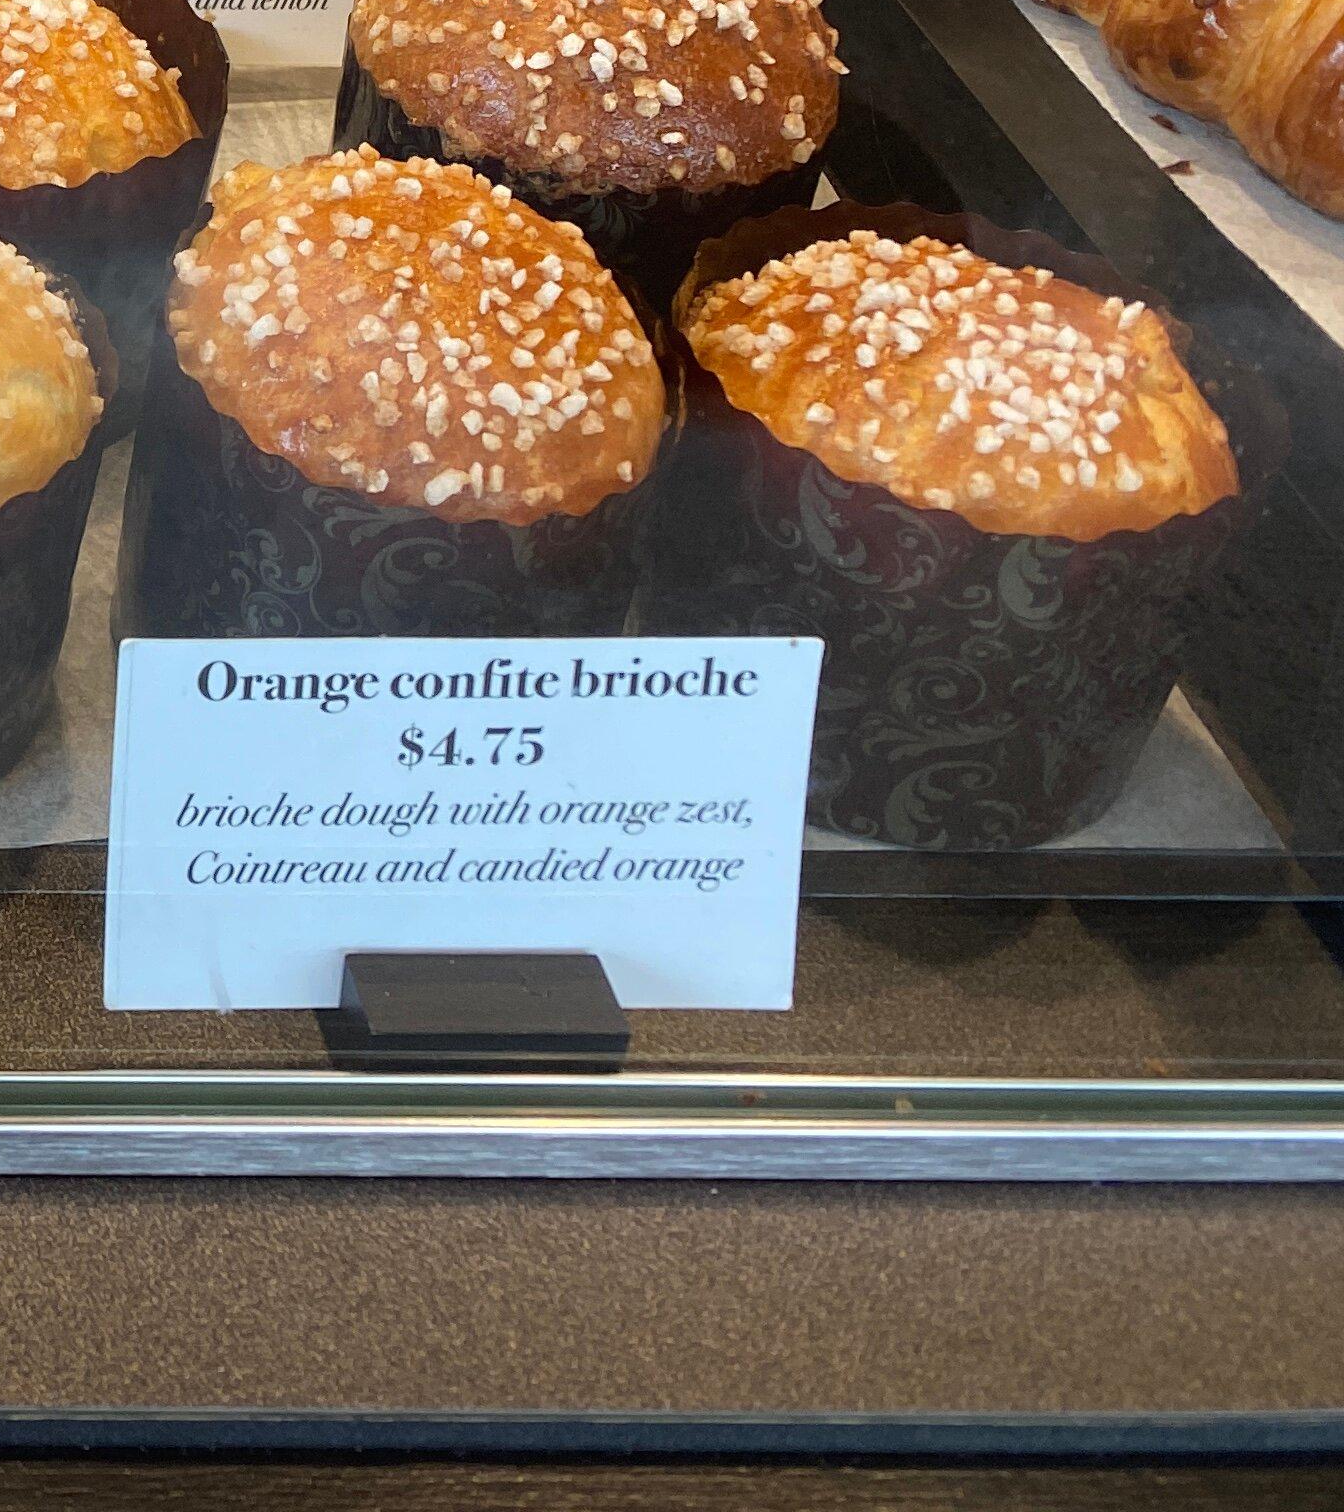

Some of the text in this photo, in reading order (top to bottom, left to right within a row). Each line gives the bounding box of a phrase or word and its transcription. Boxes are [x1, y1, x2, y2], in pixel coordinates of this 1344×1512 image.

[197, 657, 759, 713] Orange confite brioche
[397, 724, 545, 769] $4.75
[176, 792, 753, 836] brioche dough with orange zest,
[186, 848, 744, 890] Cointreau and candied orange
